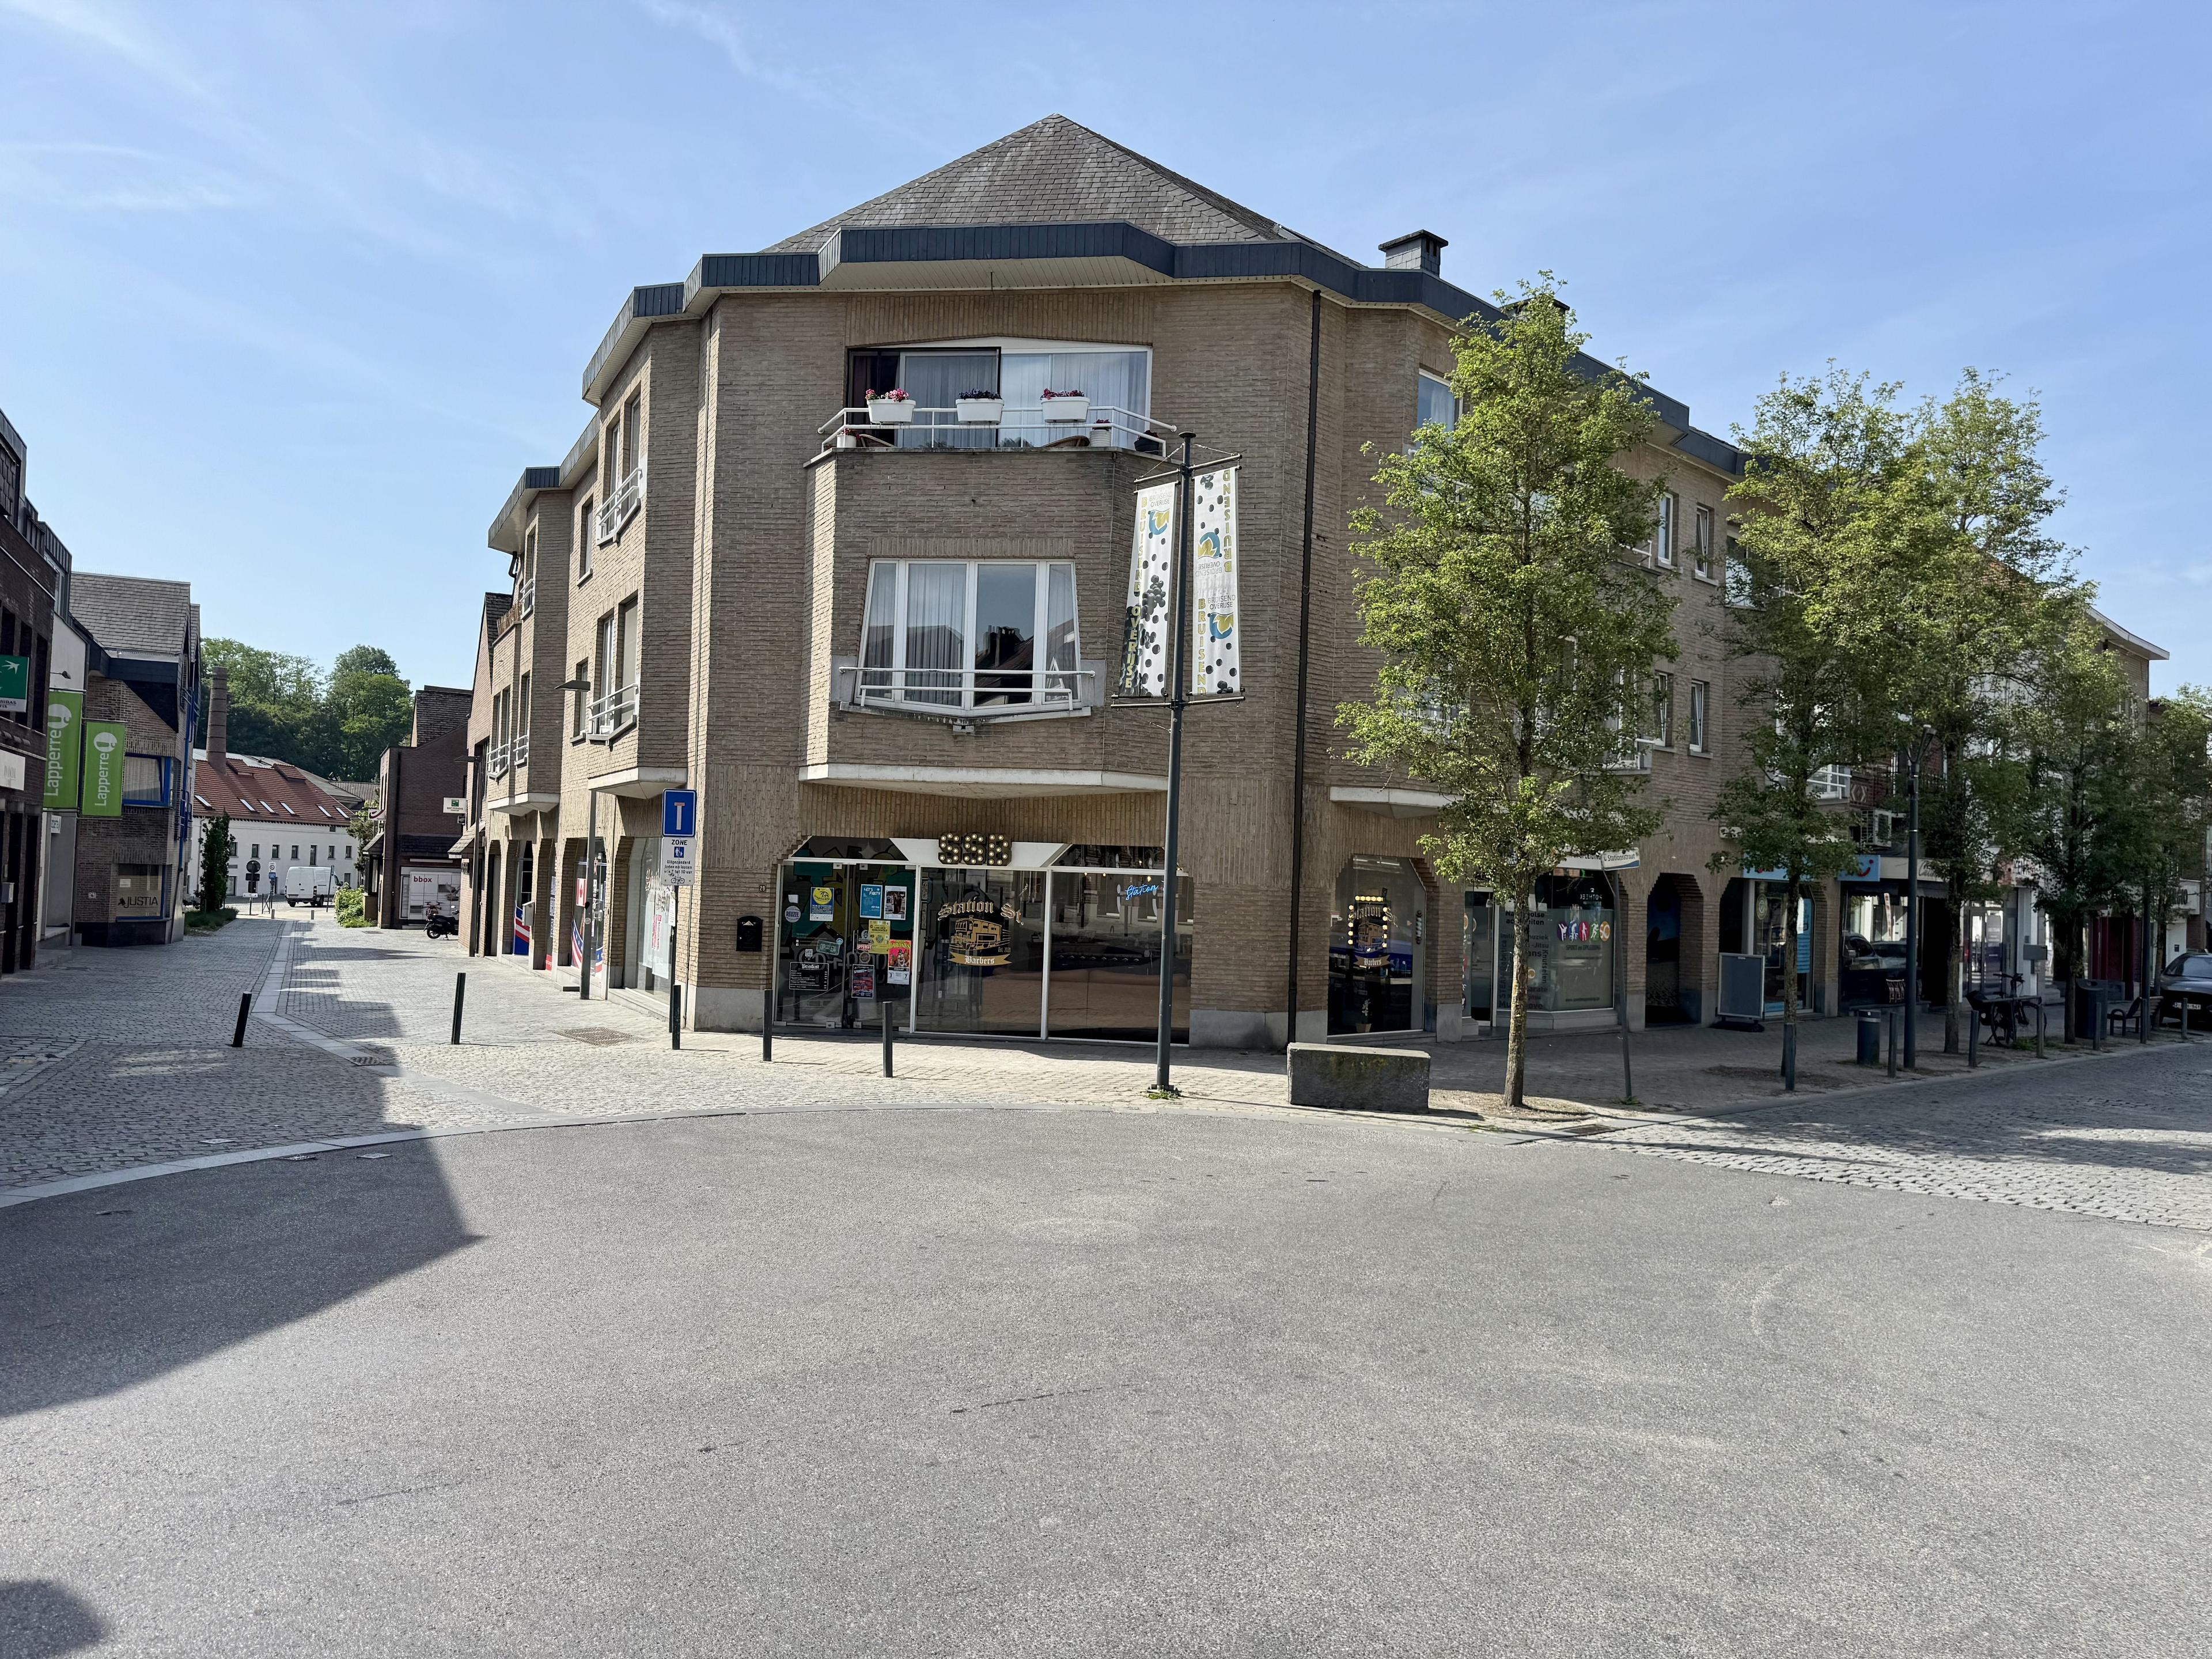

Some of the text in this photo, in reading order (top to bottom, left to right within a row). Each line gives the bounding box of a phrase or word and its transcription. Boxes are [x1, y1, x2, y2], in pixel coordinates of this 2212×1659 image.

[1150, 491, 1173, 502] BRUISEND
[1134, 497, 1148, 597] BRUISEND
[1207, 594, 1236, 604] BRUISEND
[1210, 601, 1233, 610] OVERIJSE
[1125, 606, 1141, 688] OVERIJSE
[1198, 598, 1207, 695] BRUISEND
[44, 729, 63, 797] Lapperre
[94, 752, 110, 806] Lapperre
[938, 832, 1012, 866] SSB
[1608, 854, 1635, 862] Stationsstraat
[1125, 884, 1159, 901] Station
[124, 896, 158, 908] JUSTIA
[937, 896, 1024, 926] Station St.
[964, 955, 995, 965] Barbers
[1363, 957, 1382, 966] Barbers
